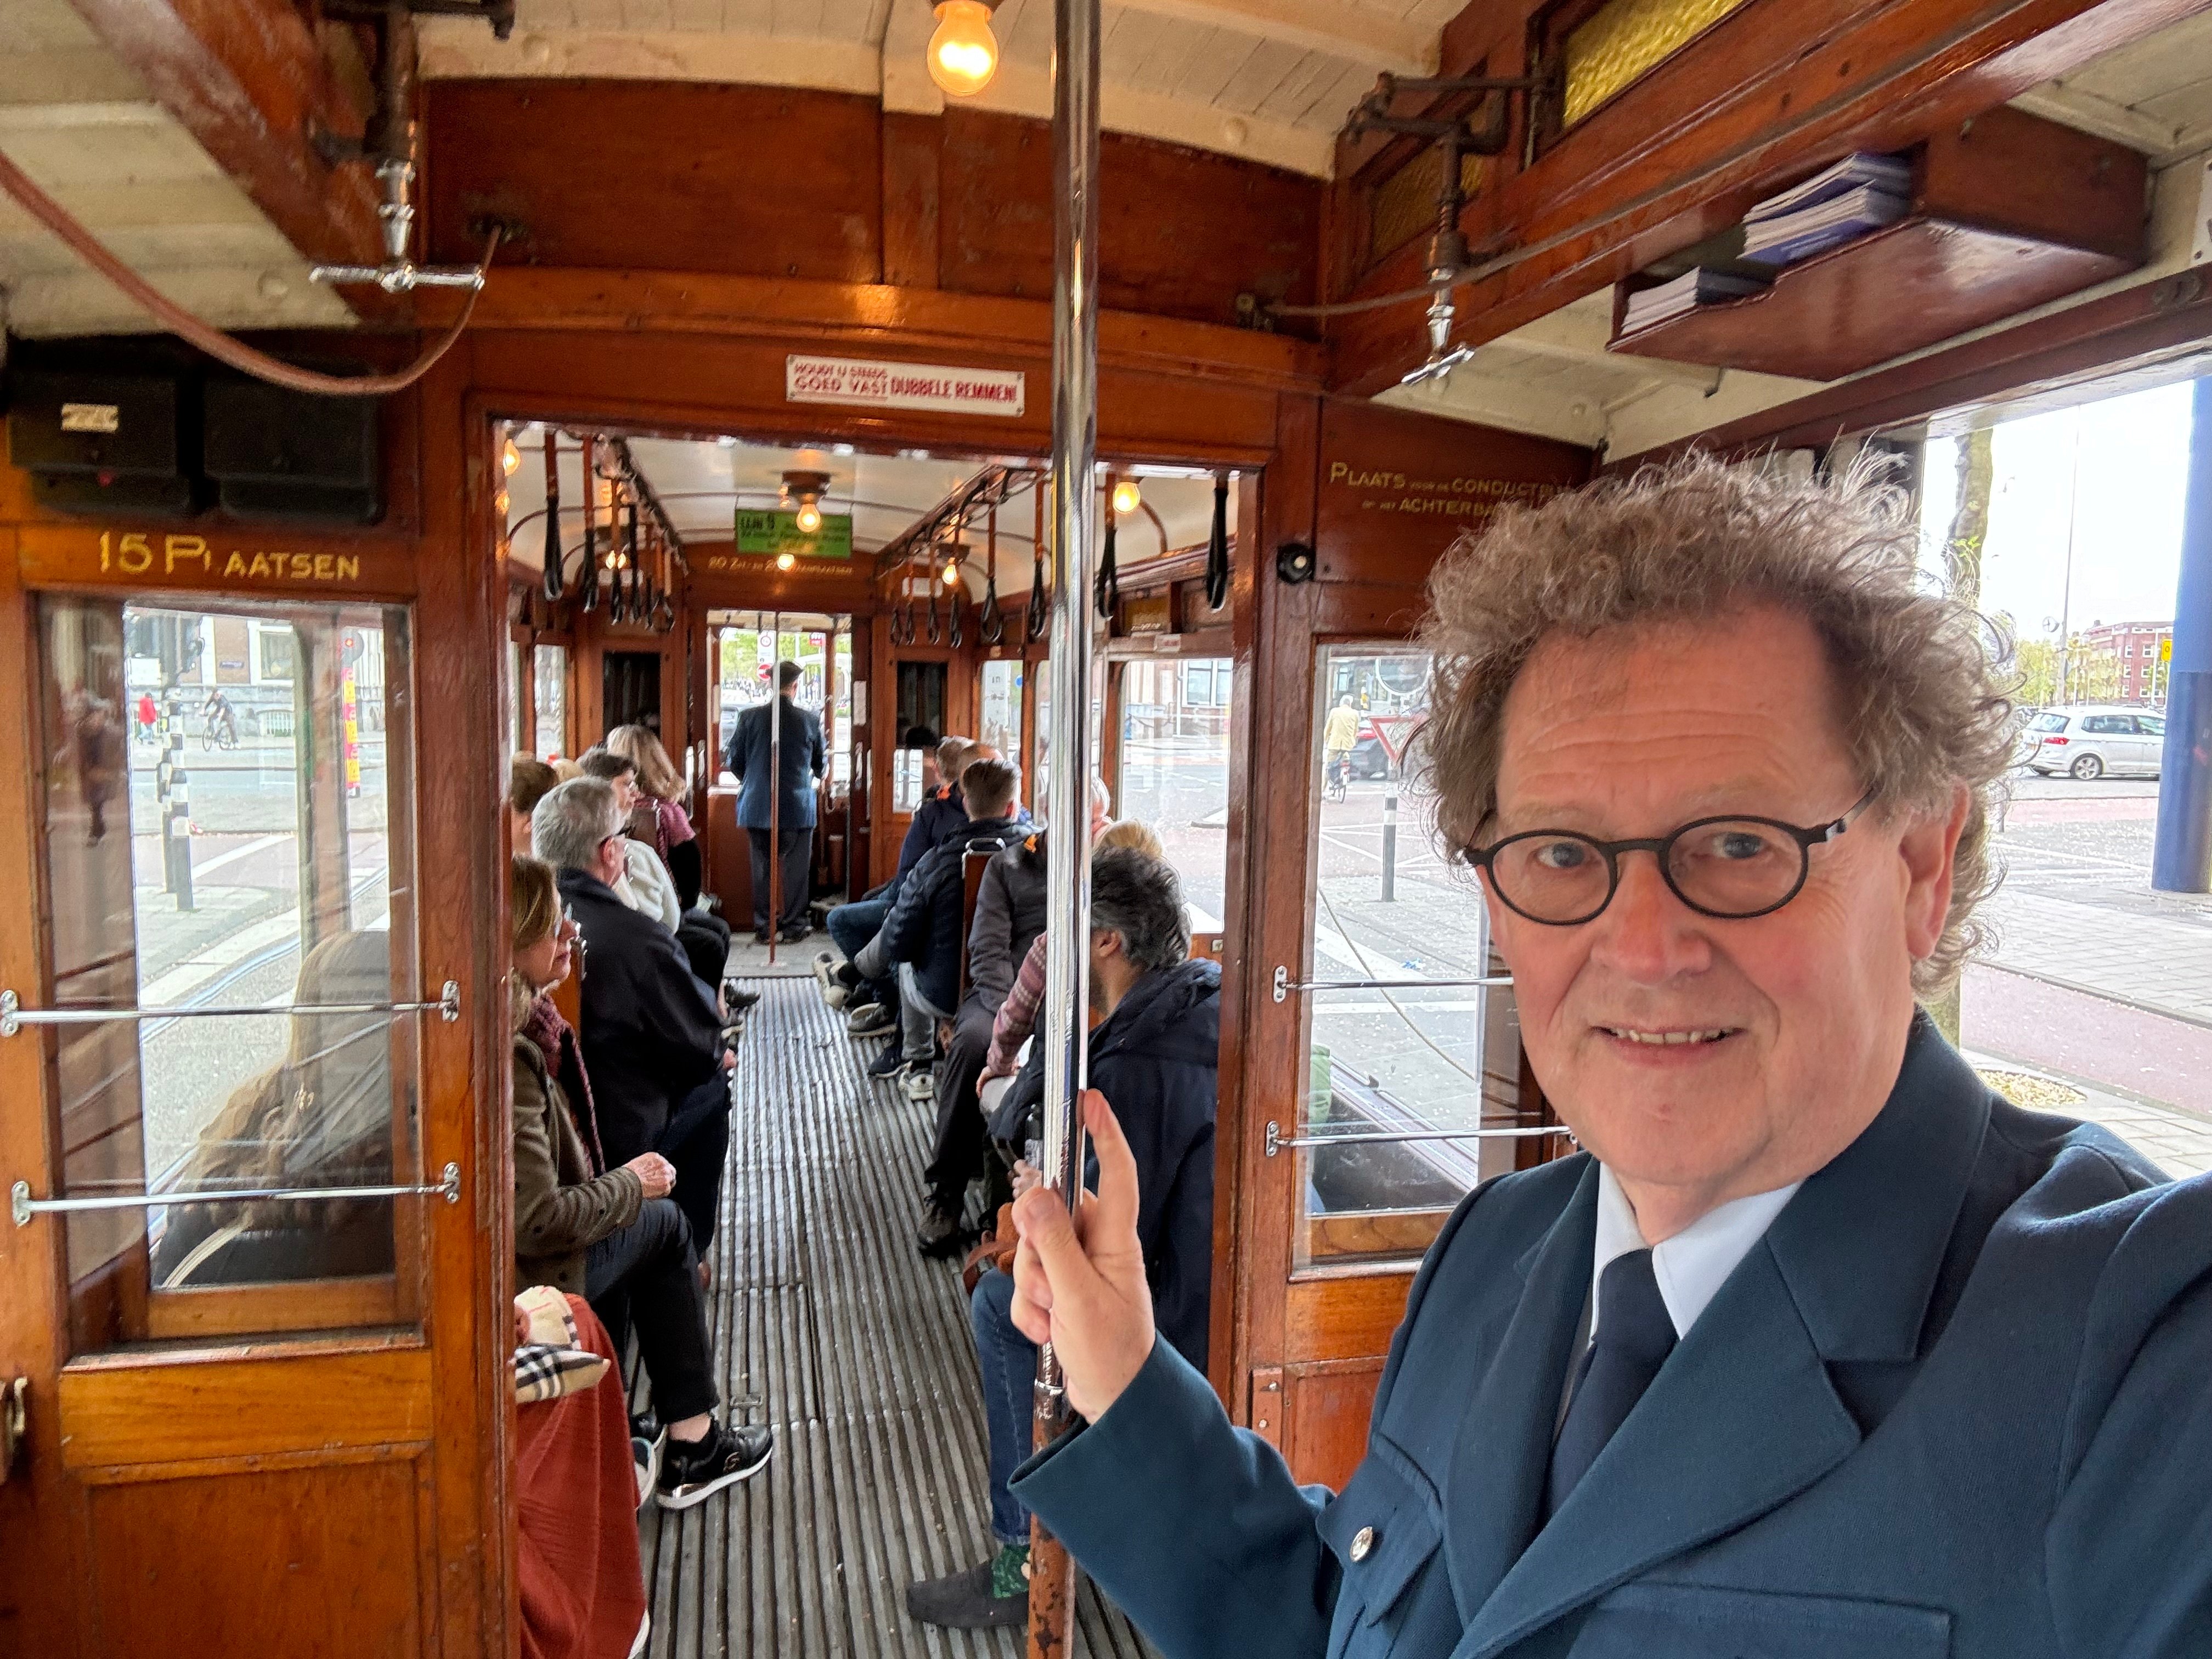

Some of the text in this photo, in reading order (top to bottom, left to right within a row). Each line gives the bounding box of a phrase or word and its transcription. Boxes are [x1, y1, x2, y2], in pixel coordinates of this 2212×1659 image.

[795, 375, 888, 394] GOED VAST
[890, 376, 1018, 403] DUBBELE REMMEN
[1329, 461, 1406, 489] PLAATS
[99, 531, 154, 575] 15
